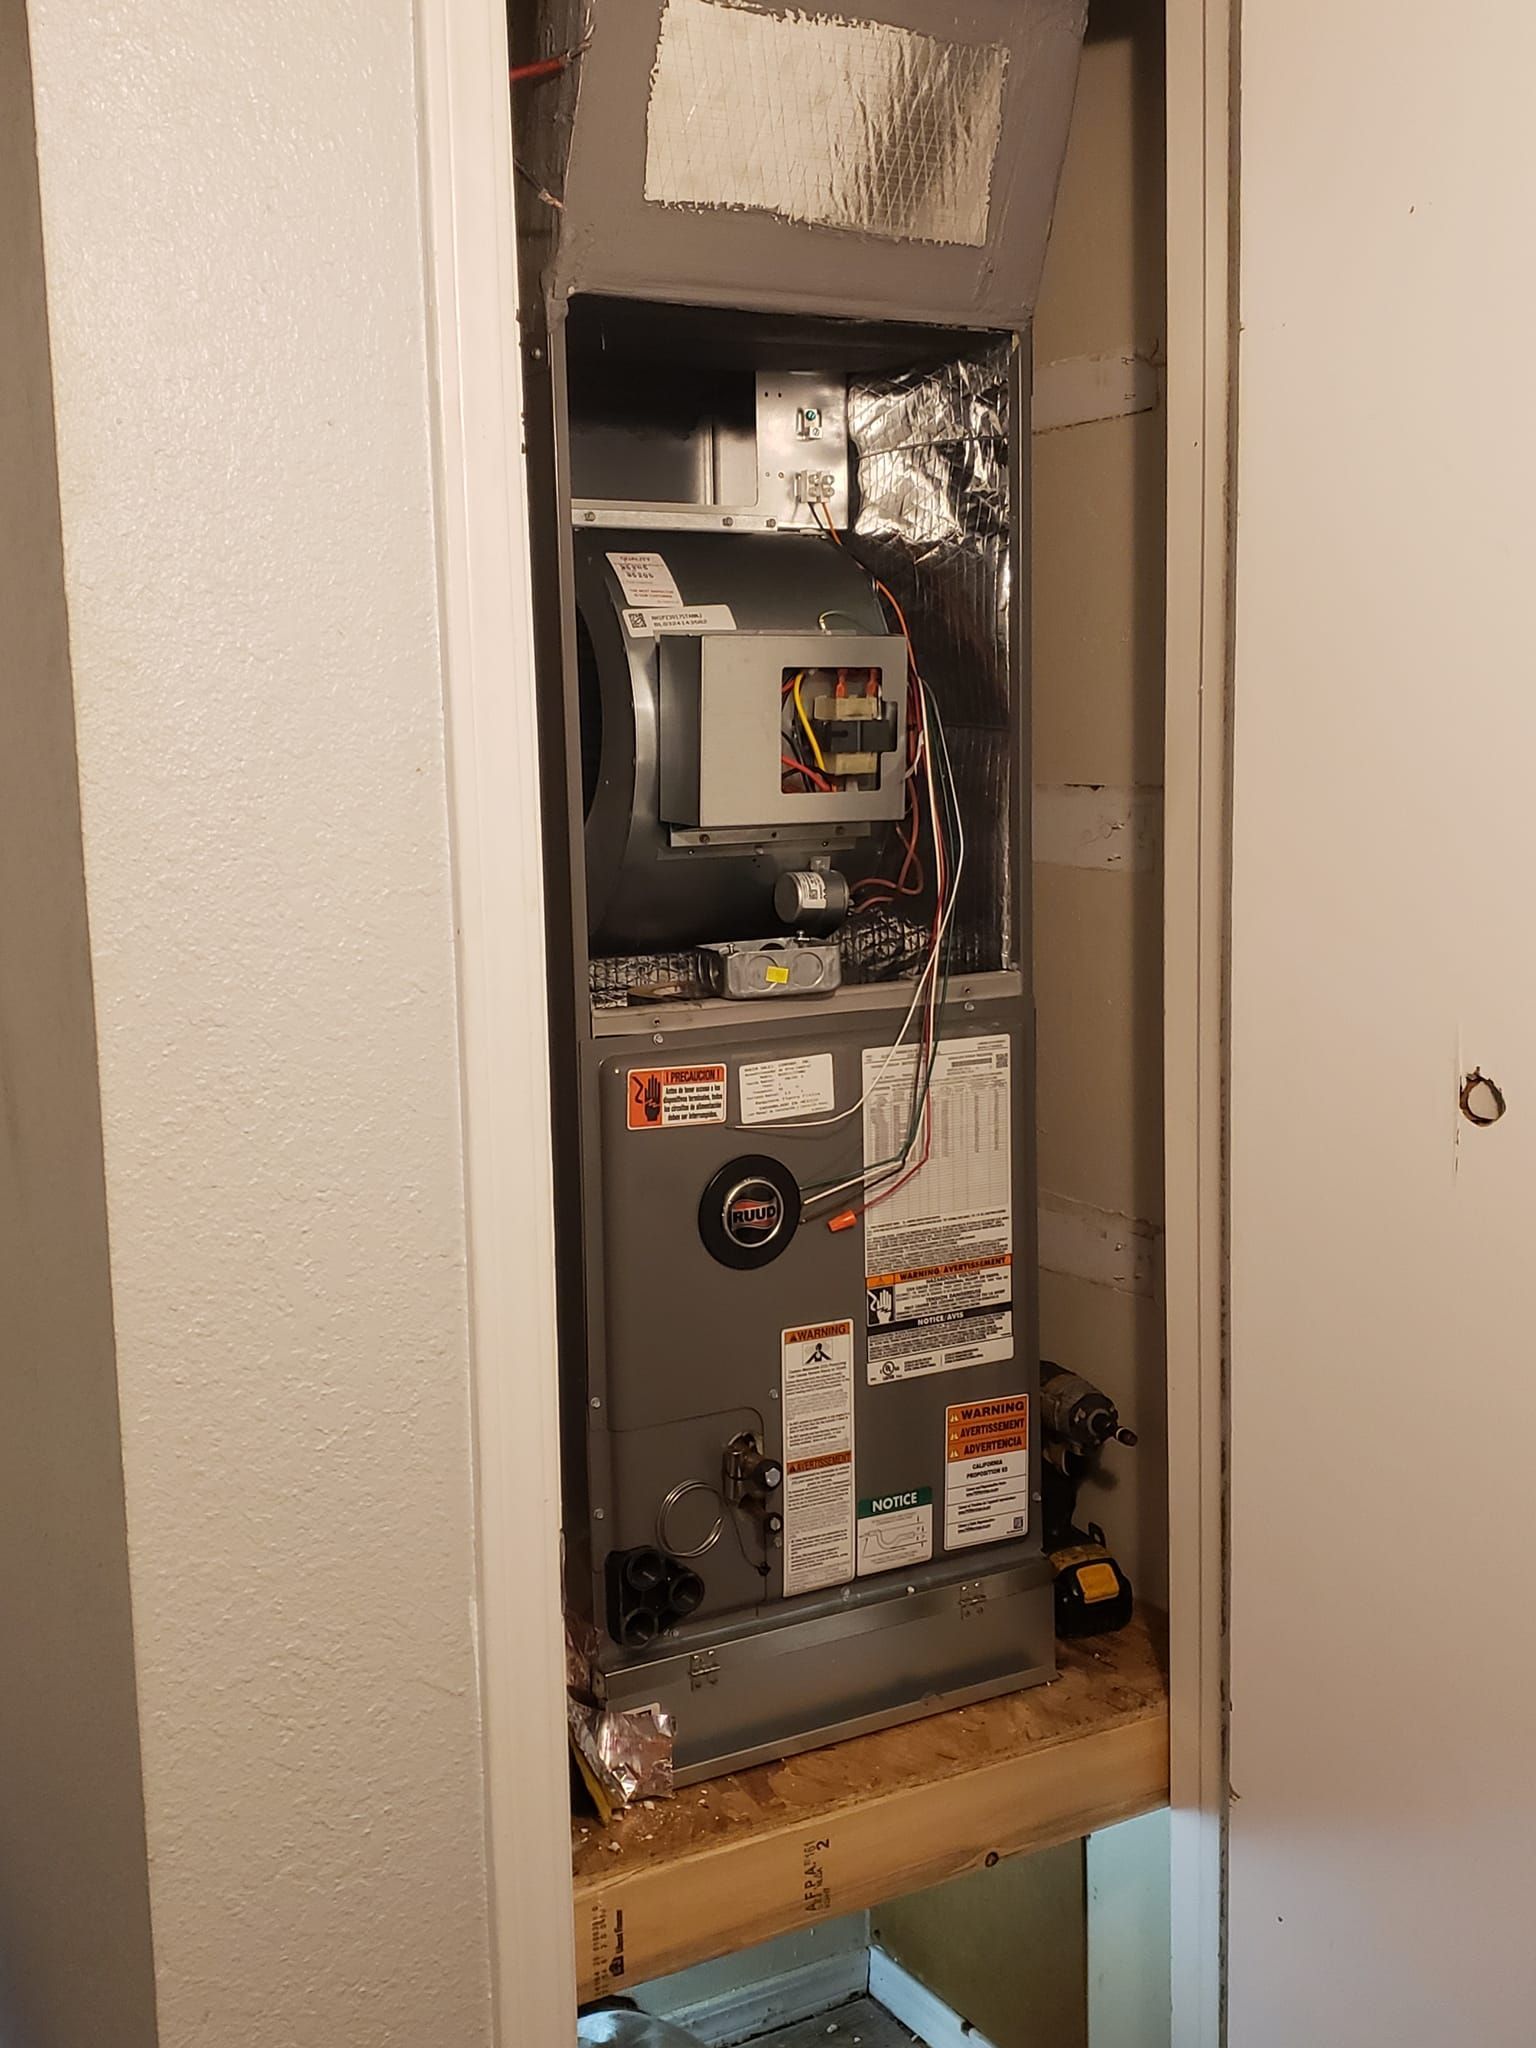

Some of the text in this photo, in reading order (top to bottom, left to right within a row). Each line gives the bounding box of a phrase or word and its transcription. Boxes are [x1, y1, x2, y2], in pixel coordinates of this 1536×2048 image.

[733, 1205, 776, 1224] RUUD
[900, 1256, 1006, 1281] WARNING AVERTISSEMENT
[797, 1324, 846, 1341] WARNING
[961, 1401, 1025, 1421] WARNING
[960, 1418, 1025, 1438] AVERTISSEMENT
[963, 1436, 1022, 1456] ADVERTENCIA
[972, 1459, 1003, 1470] CALIFORNIA
[872, 1491, 918, 1513] NOTICE
[816, 1838, 830, 1851] 2
